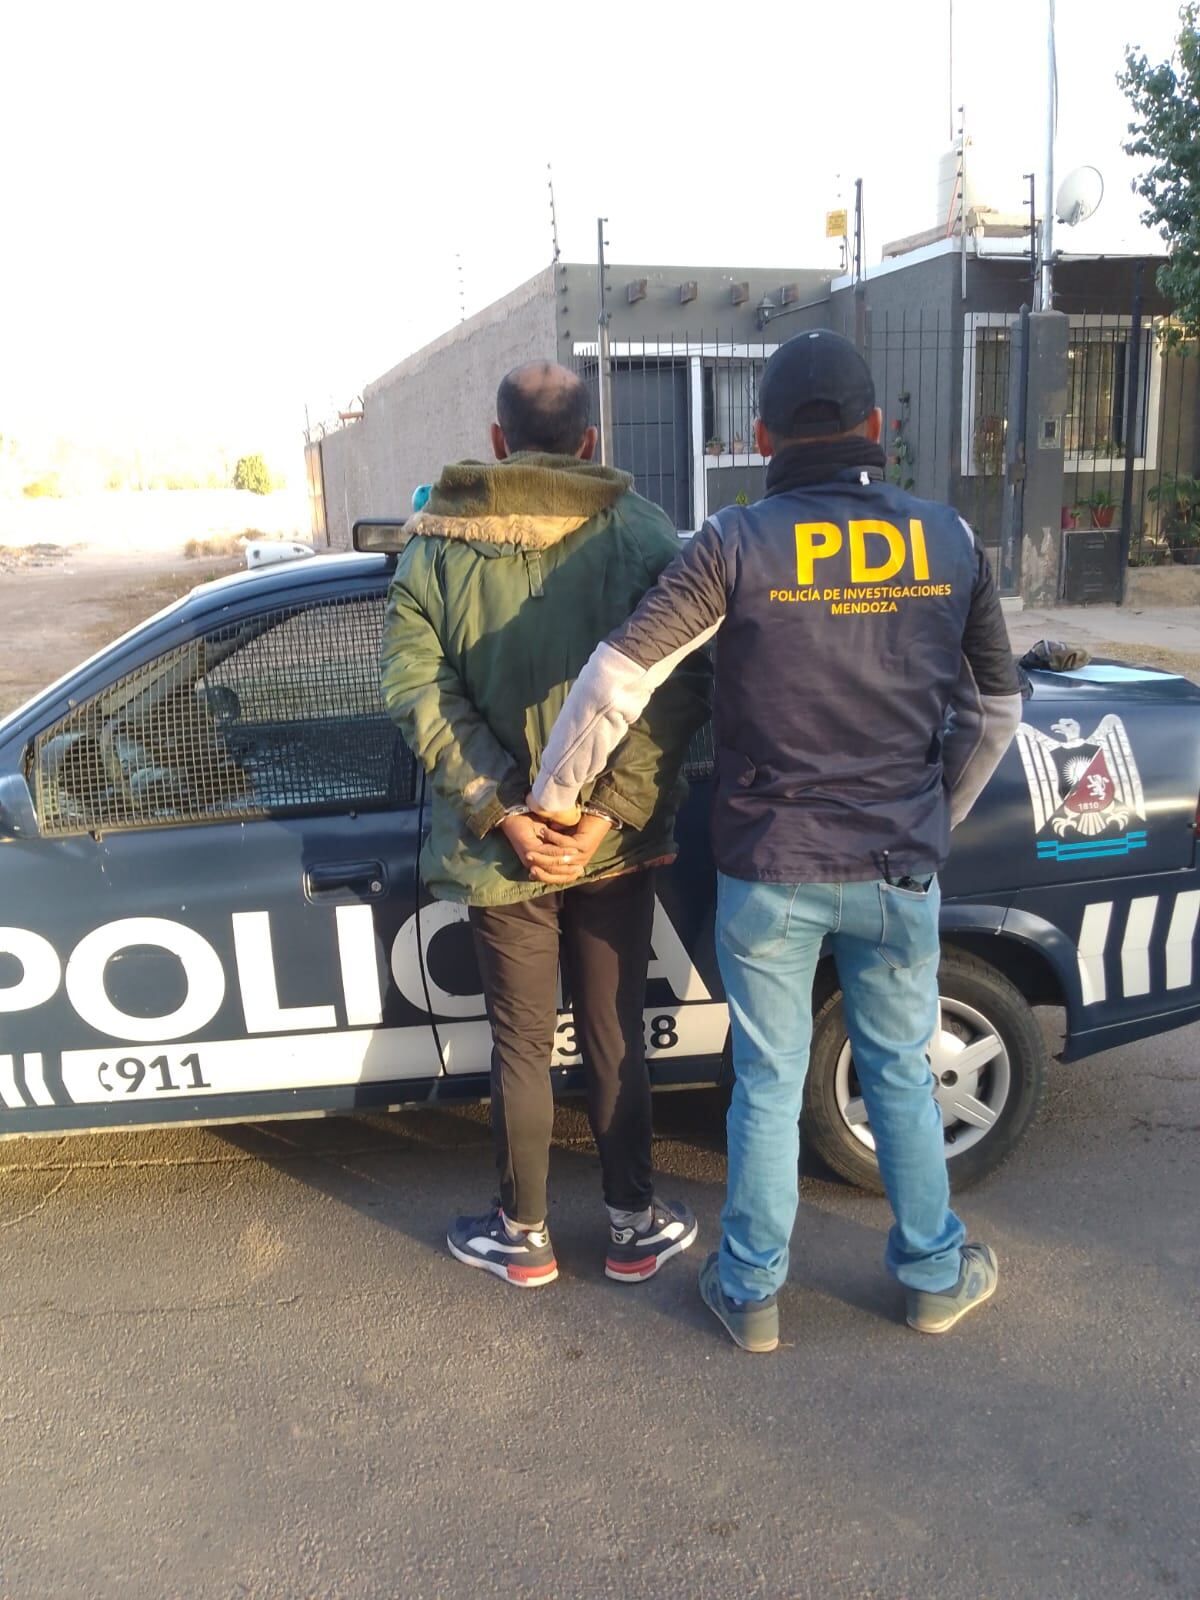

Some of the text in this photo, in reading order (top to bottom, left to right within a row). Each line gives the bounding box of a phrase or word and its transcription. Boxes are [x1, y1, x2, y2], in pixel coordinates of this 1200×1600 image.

[794, 518, 930, 586] PDI
[769, 583, 952, 602] POLICÍA DE INVESTIGACIONES
[831, 601, 898, 615] MENDOZA
[115, 1053, 212, 1093] 911
